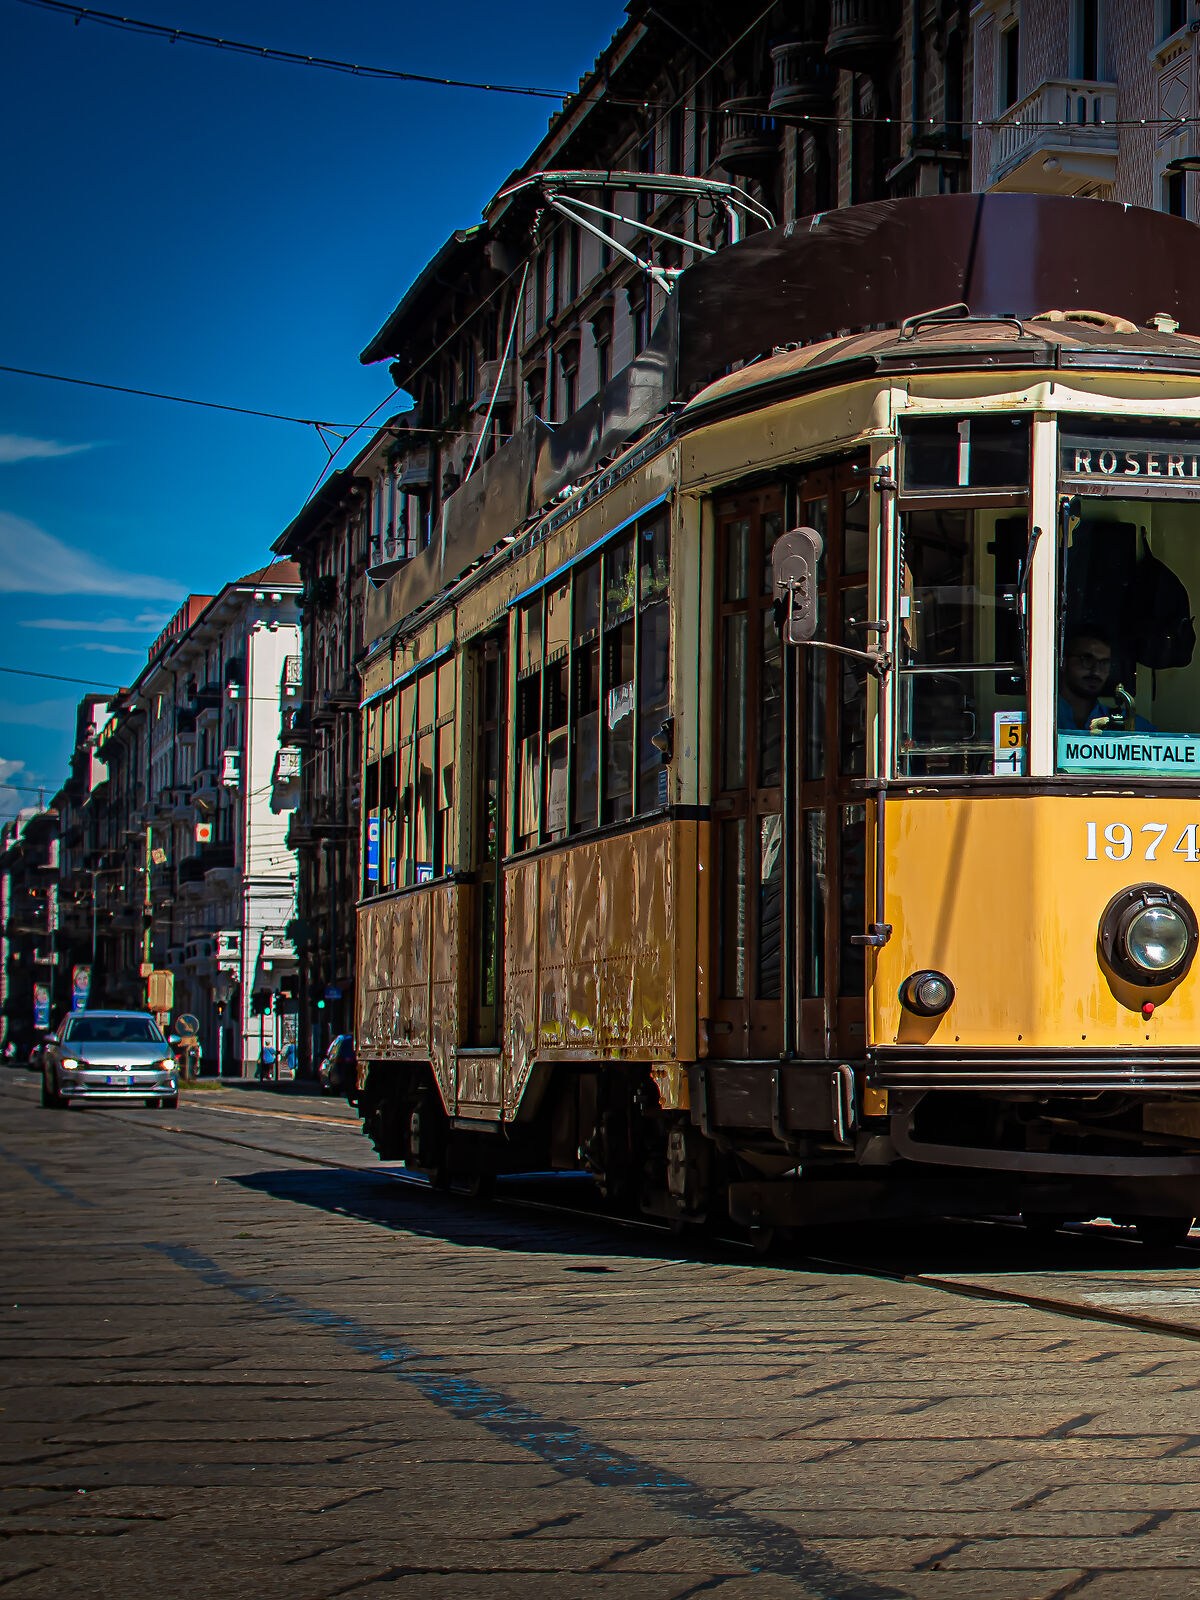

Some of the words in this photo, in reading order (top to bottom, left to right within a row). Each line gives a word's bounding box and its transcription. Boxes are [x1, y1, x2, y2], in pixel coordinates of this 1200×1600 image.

[957, 419, 971, 486] 1
[1008, 725, 1019, 747] 5
[1008, 751, 1017, 772] 1
[1066, 743, 1195, 763] MONUMENTALE
[1085, 821, 1200, 863] 1974
